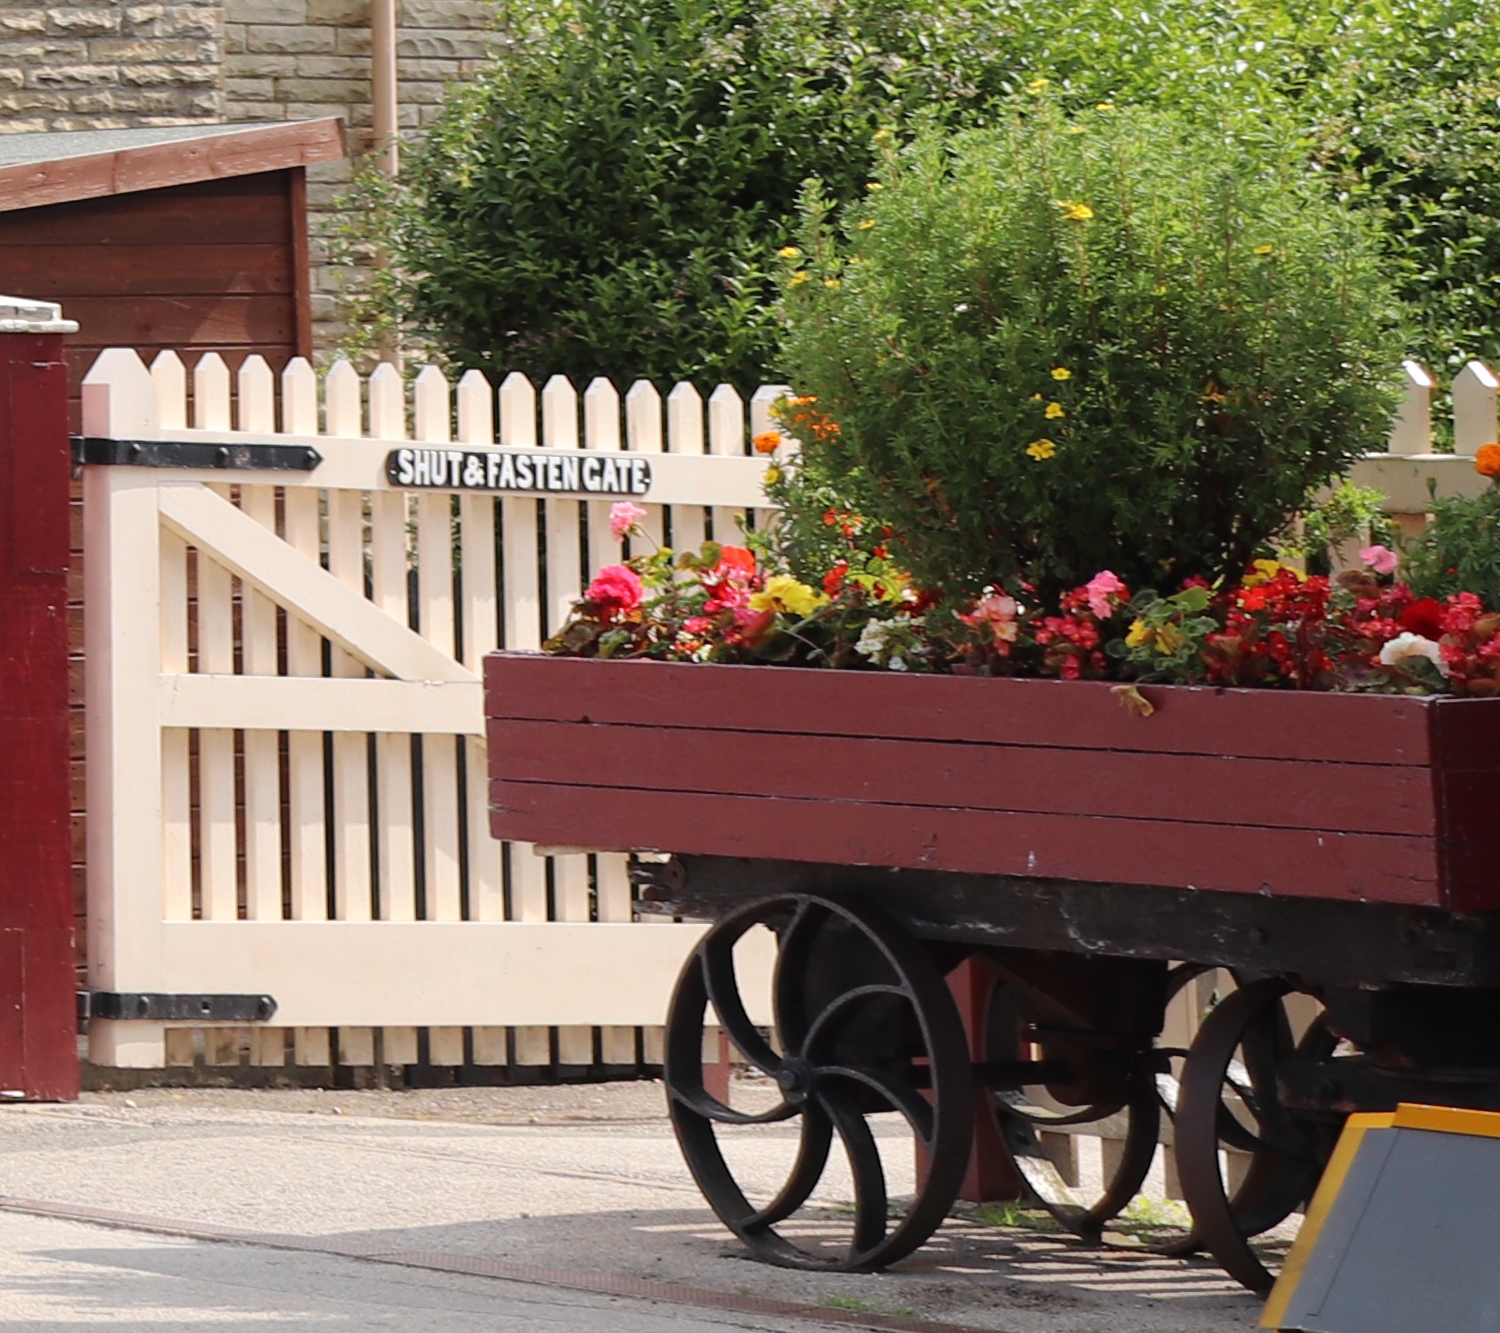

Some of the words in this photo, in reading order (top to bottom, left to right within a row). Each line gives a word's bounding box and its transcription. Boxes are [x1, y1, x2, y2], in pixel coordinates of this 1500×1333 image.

[398, 449, 463, 487] SHUT
[486, 453, 579, 491] FASTEN
[582, 457, 647, 494] GATE
